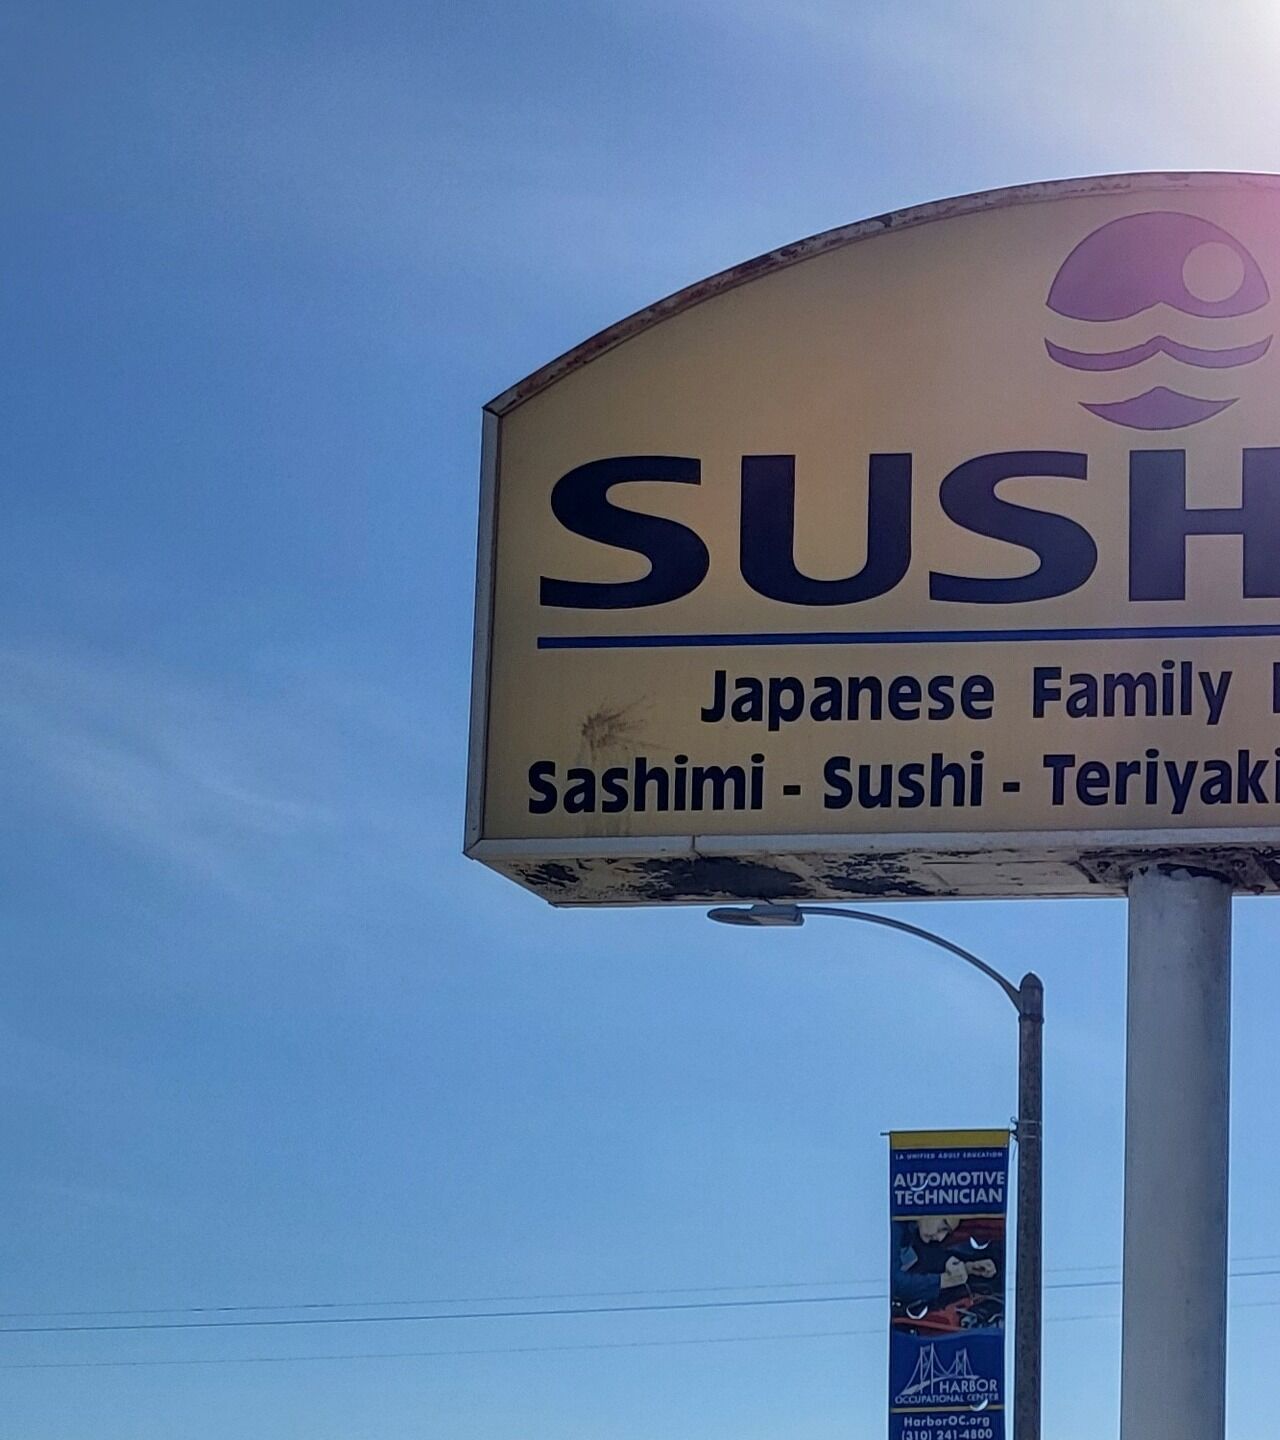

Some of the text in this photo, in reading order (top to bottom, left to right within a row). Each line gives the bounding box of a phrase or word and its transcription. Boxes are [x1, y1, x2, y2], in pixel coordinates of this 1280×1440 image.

[700, 669, 995, 732] Japanese
[1032, 659, 1233, 725] Family
[527, 752, 765, 815] Sashimi
[823, 749, 984, 810] Sushi
[895, 1150, 1003, 1161] LA UNIFIED ADULT EDUCATION
[894, 1171, 1005, 1188] AUTOMOTIVE
[895, 1188, 1003, 1206] TECHNICIAN
[939, 1378, 999, 1394] HARBOR
[894, 1393, 1000, 1405] OCCUPATIONAL CENTER
[903, 1415, 991, 1428] HarborOC.org
